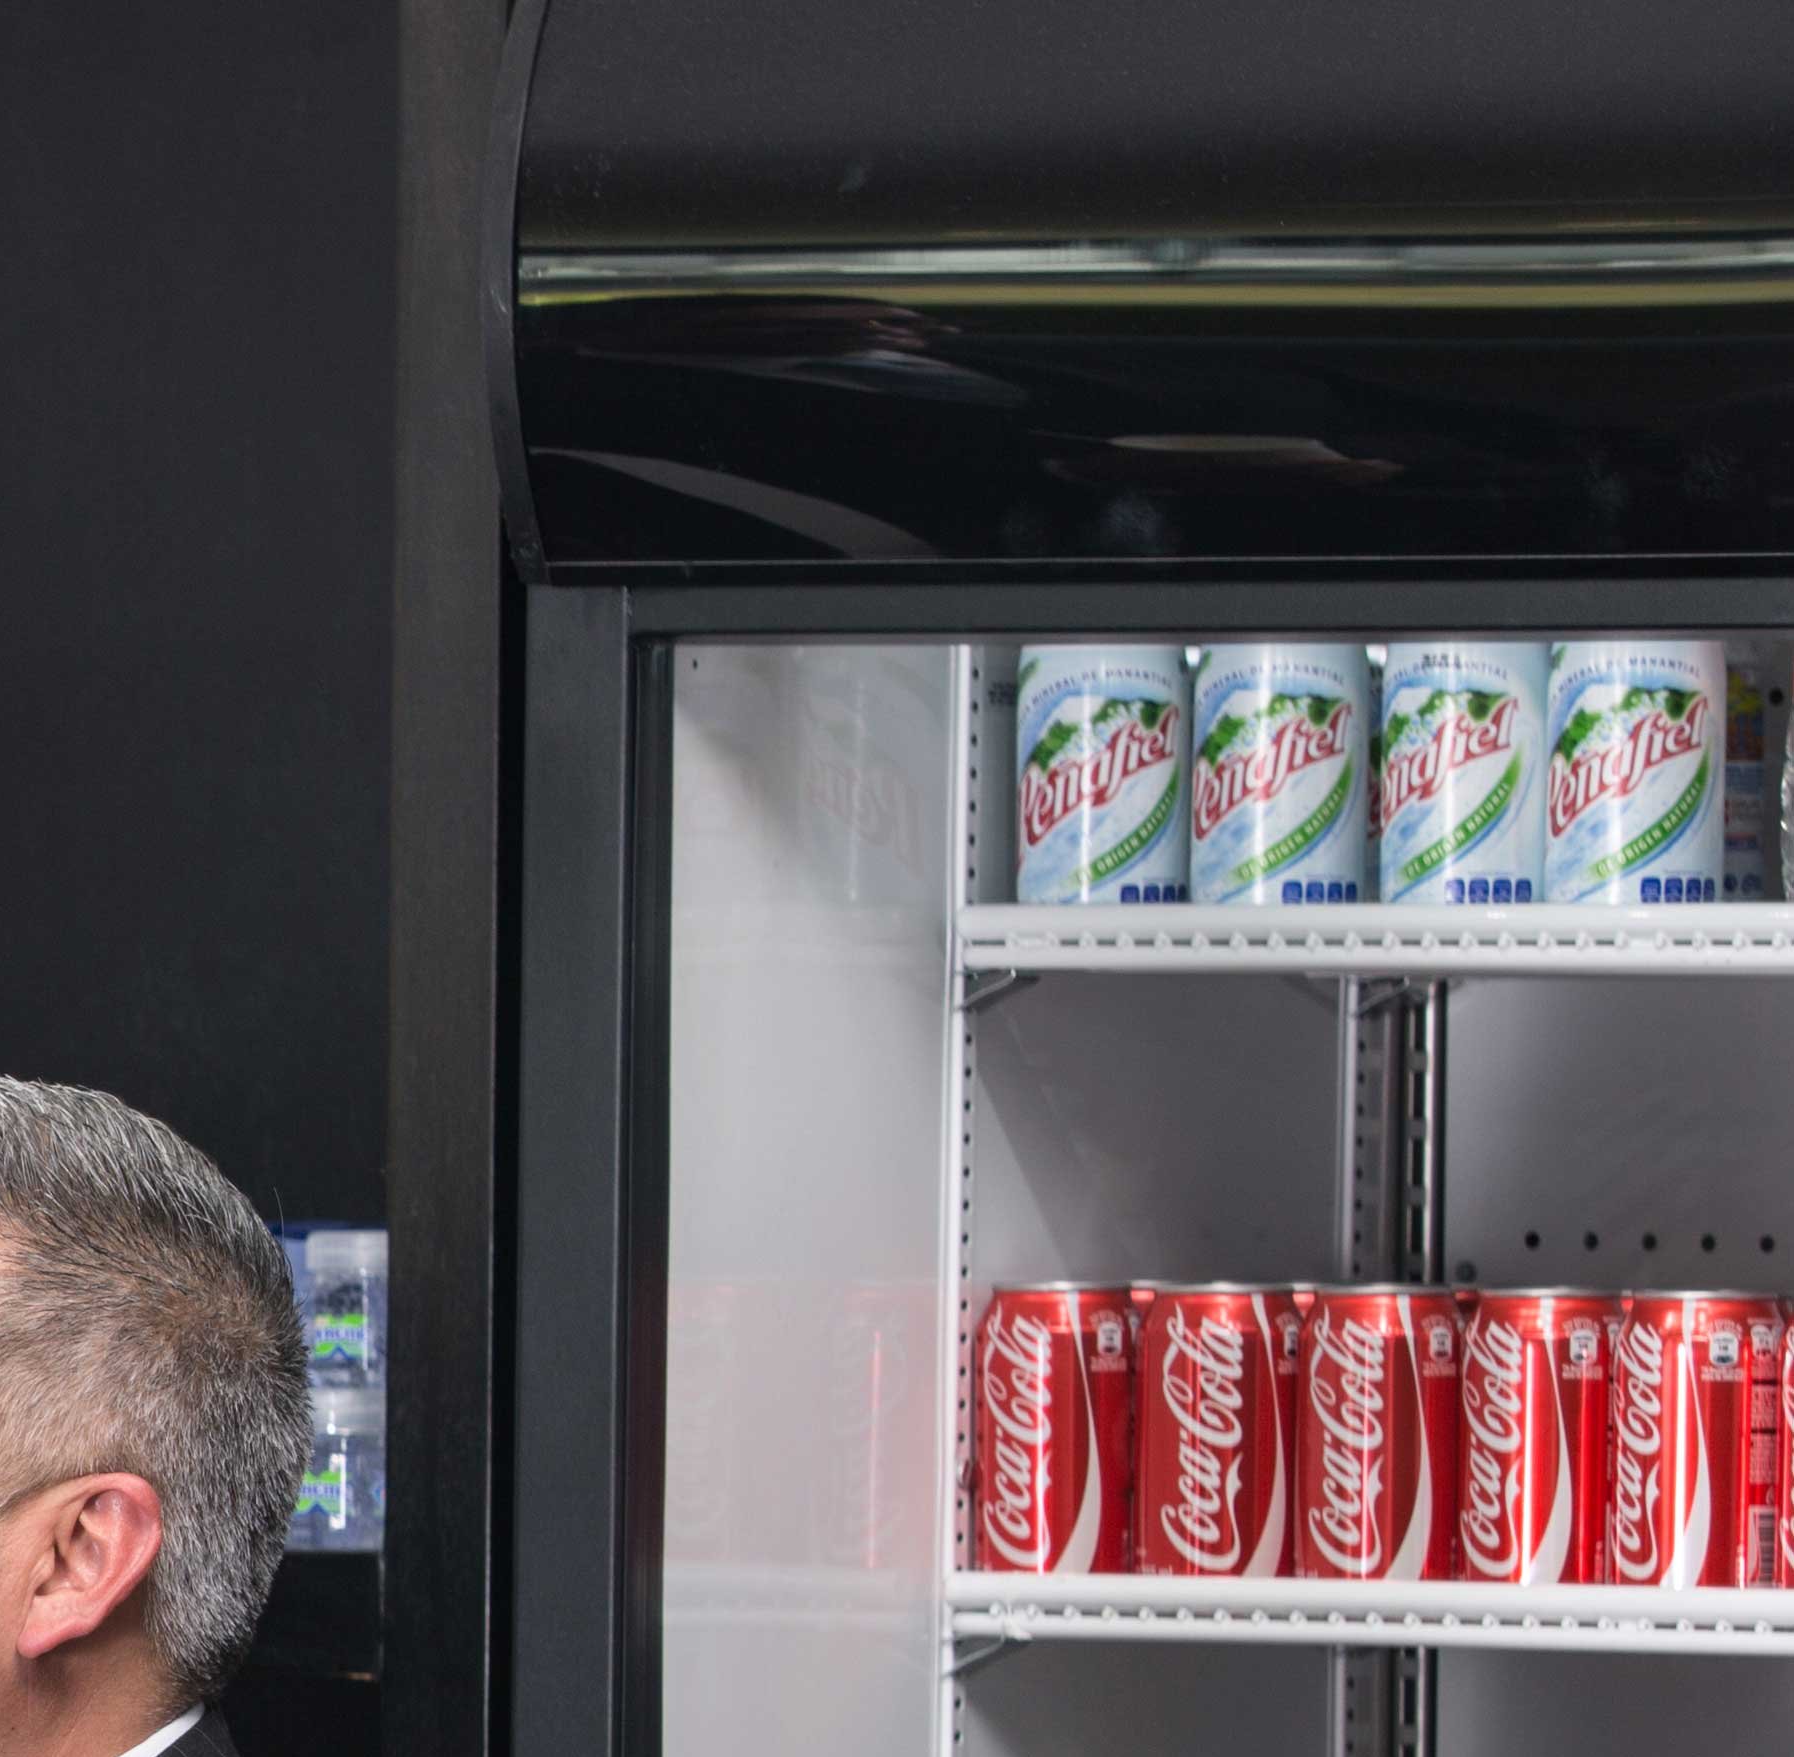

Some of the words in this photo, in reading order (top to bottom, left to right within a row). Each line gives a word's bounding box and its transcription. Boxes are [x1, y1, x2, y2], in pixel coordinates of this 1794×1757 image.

[983, 1303, 1052, 1568] Coca-Cola
[1160, 1303, 1243, 1572] Coca-Cola
[1309, 1305, 1385, 1575] Coca-Cola
[1460, 1311, 1522, 1577] Coca-Cola
[1613, 1311, 1663, 1581] Coca-Cola
